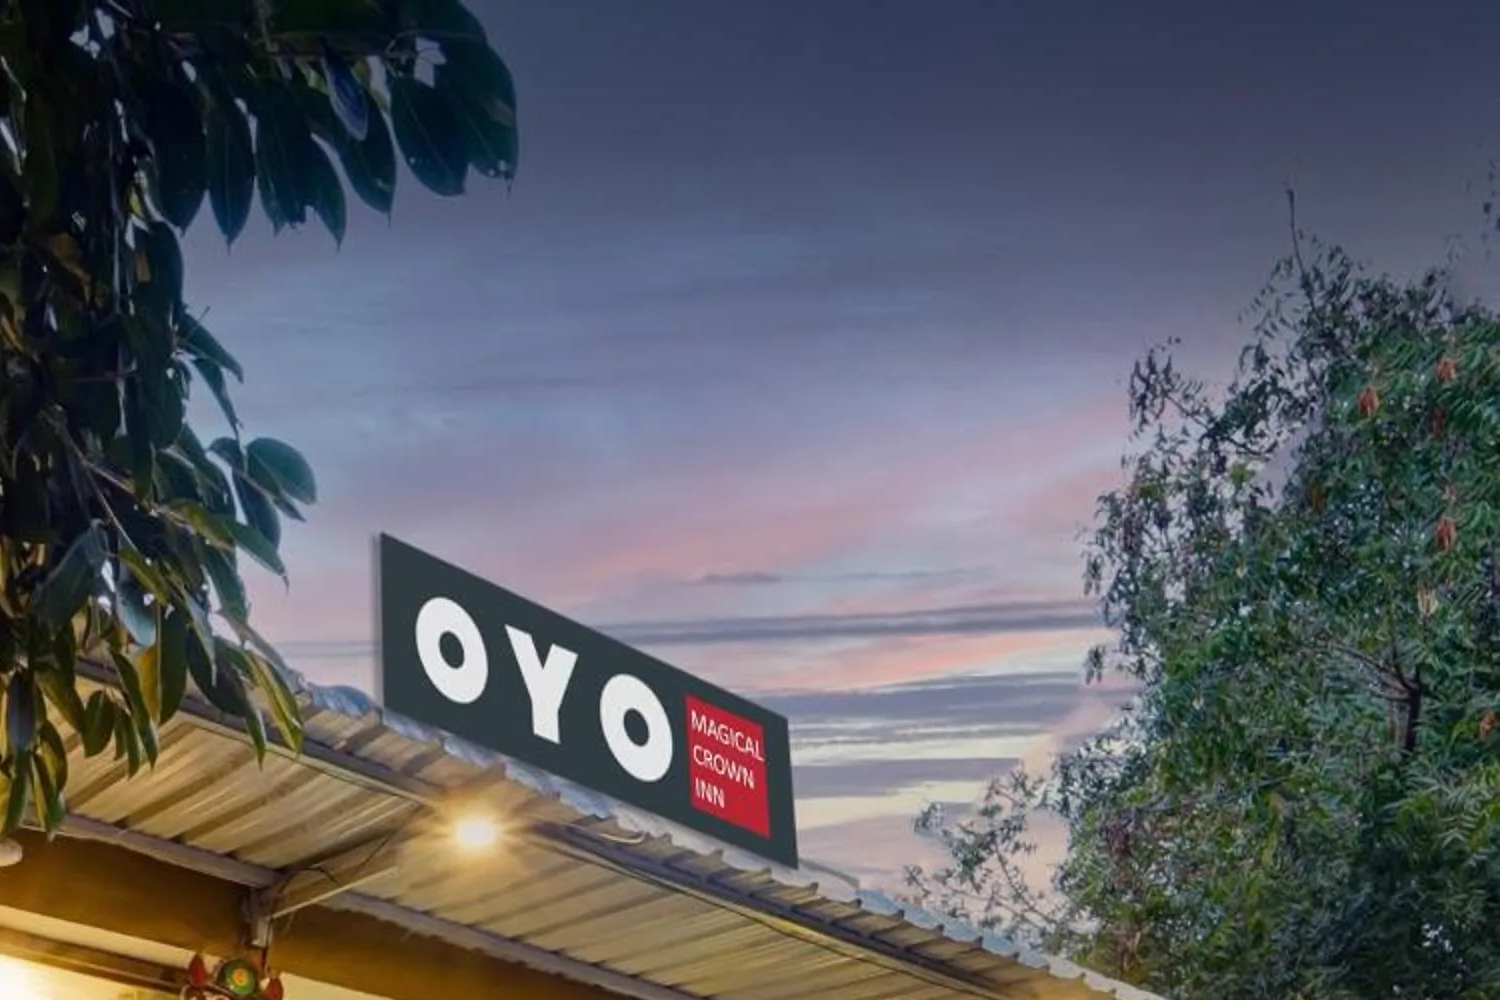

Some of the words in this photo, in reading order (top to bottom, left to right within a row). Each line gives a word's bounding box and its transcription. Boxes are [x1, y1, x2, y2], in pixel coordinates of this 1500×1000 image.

[415, 597, 674, 782] OYO
[691, 709, 765, 762] MAGICAL
[693, 745, 755, 789] CROWN
[695, 777, 725, 808] INN
